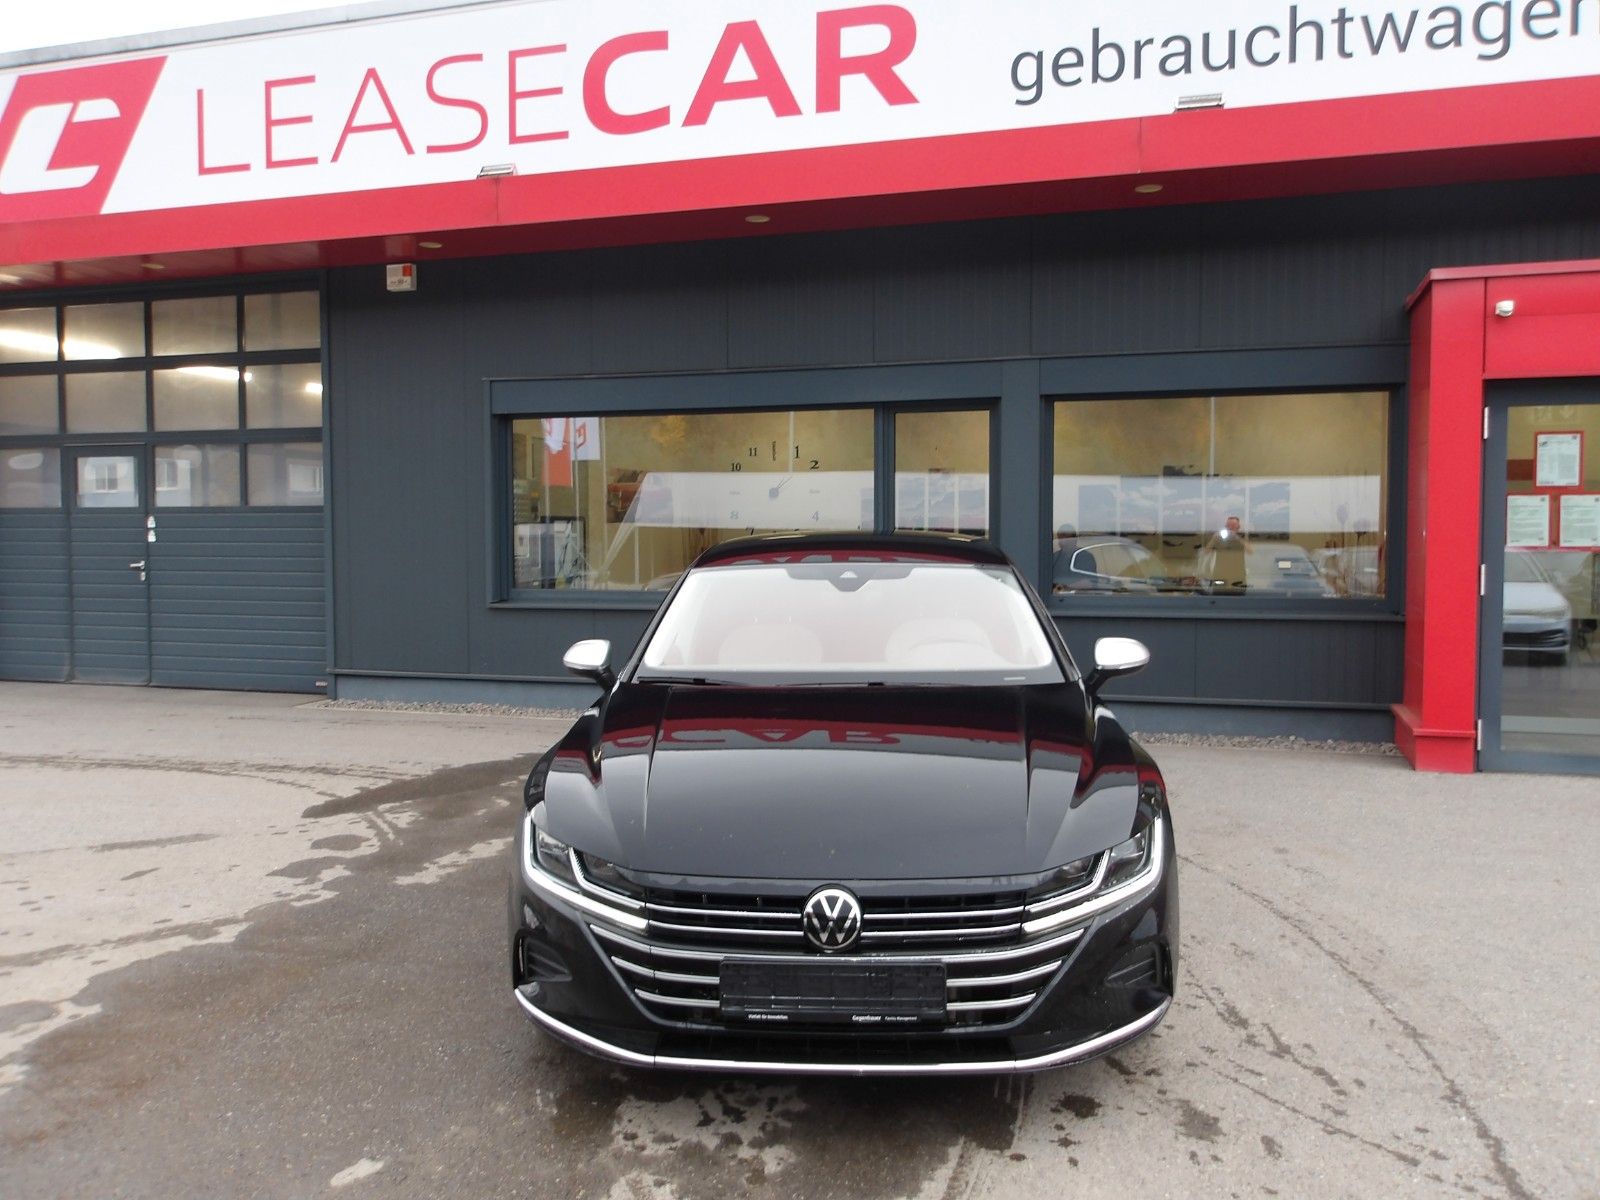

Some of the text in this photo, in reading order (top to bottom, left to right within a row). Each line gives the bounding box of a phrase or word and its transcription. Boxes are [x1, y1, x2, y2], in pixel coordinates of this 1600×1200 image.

[197, 4, 919, 177] LEASECAR
[749, 447, 757, 457] 11
[795, 445, 800, 459] 1
[731, 462, 741, 472] 10
[810, 460, 819, 470] 2
